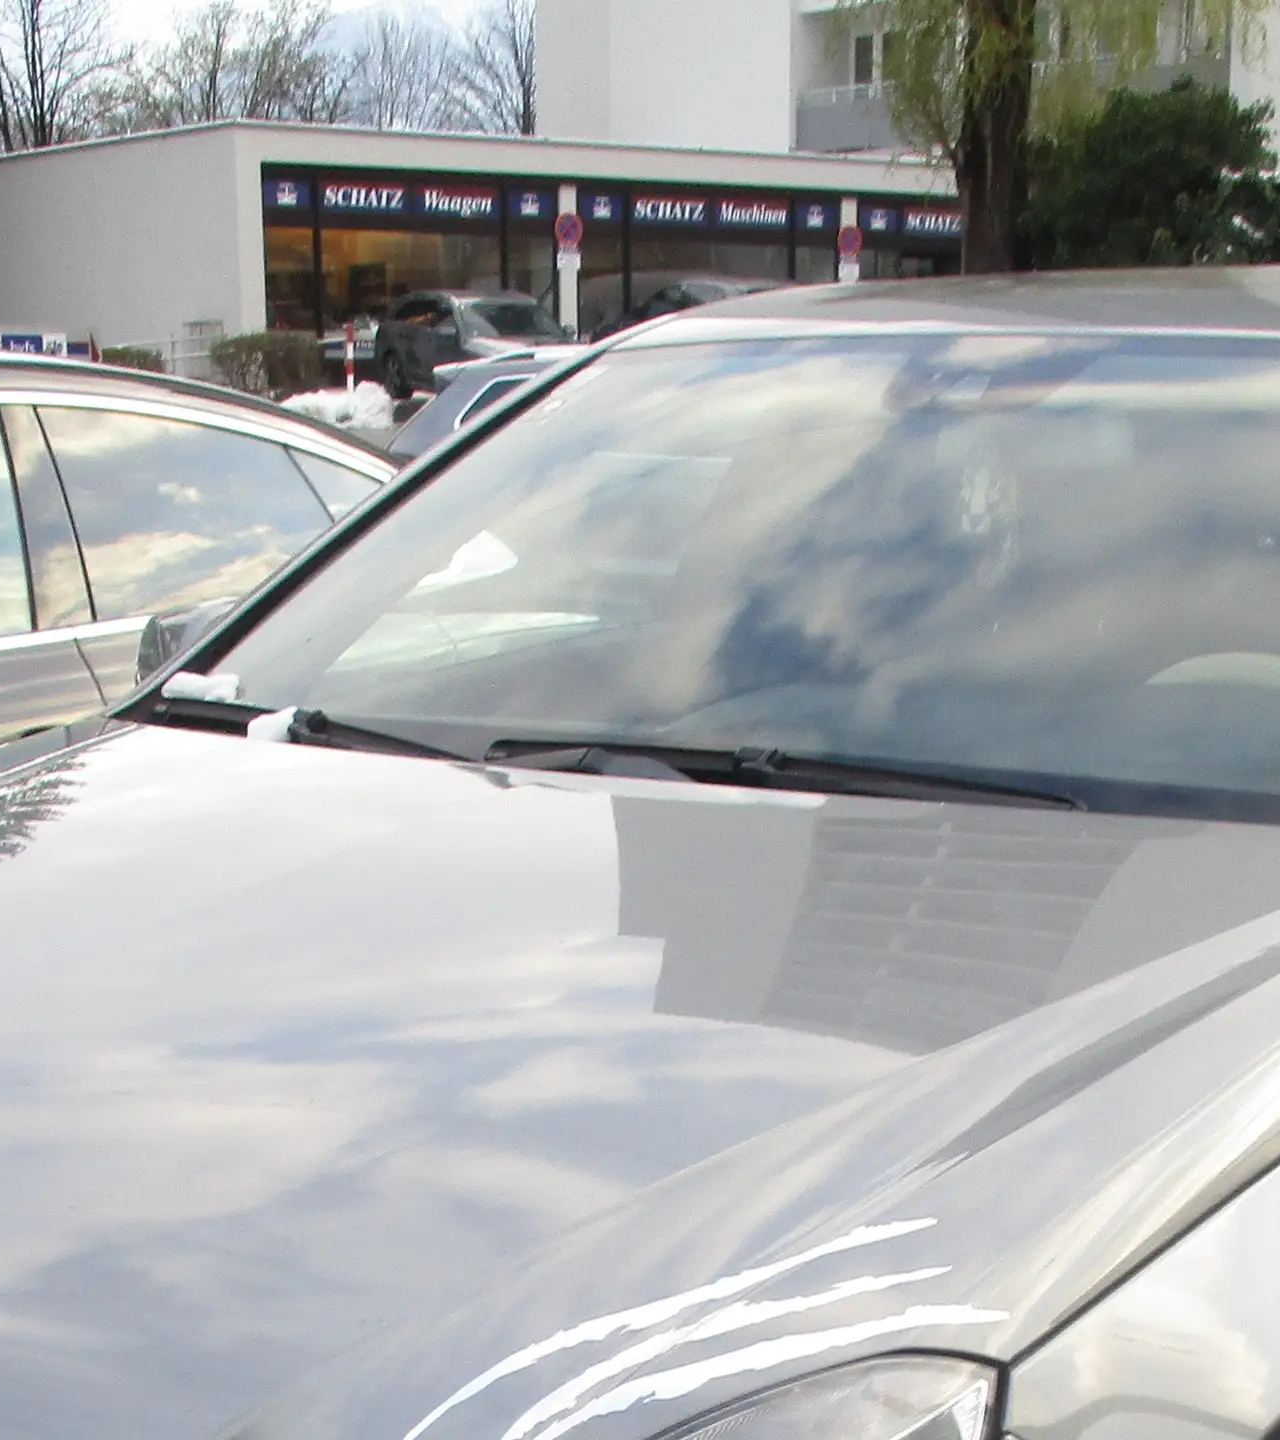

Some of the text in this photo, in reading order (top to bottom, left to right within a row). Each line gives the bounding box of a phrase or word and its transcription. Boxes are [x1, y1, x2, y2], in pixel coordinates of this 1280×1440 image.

[324, 184, 493, 216] SCHATZ Waagen
[634, 199, 788, 226] SCHATZ Maschinen
[905, 211, 962, 233] SCHATZ
